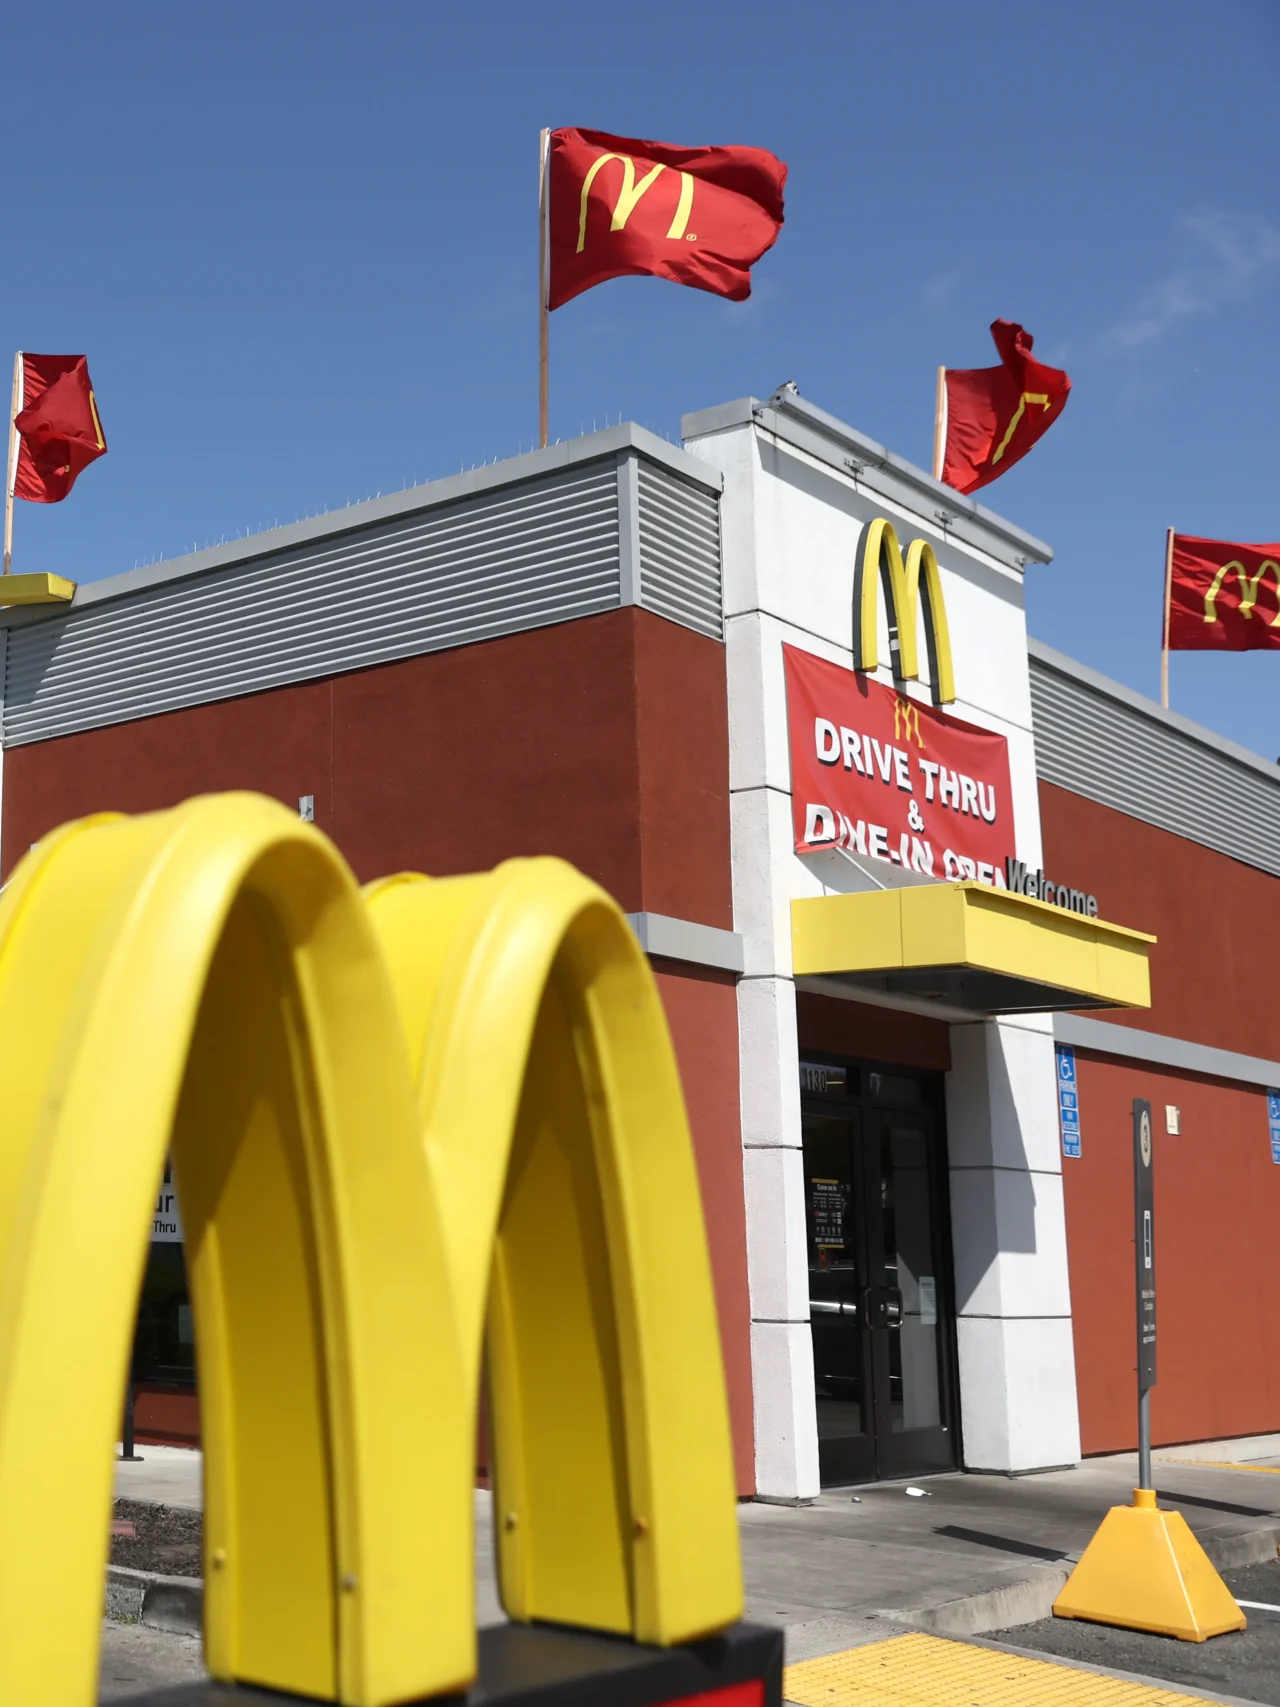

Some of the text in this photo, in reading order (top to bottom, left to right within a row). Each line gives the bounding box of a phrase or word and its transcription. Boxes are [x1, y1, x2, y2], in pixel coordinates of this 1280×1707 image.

[815, 717, 997, 824] DRIVE THRU
[804, 803, 936, 878] DINE-IN
[907, 799, 925, 834] &
[1005, 855, 1098, 919] Welcome
[807, 1068, 827, 1092] 130
